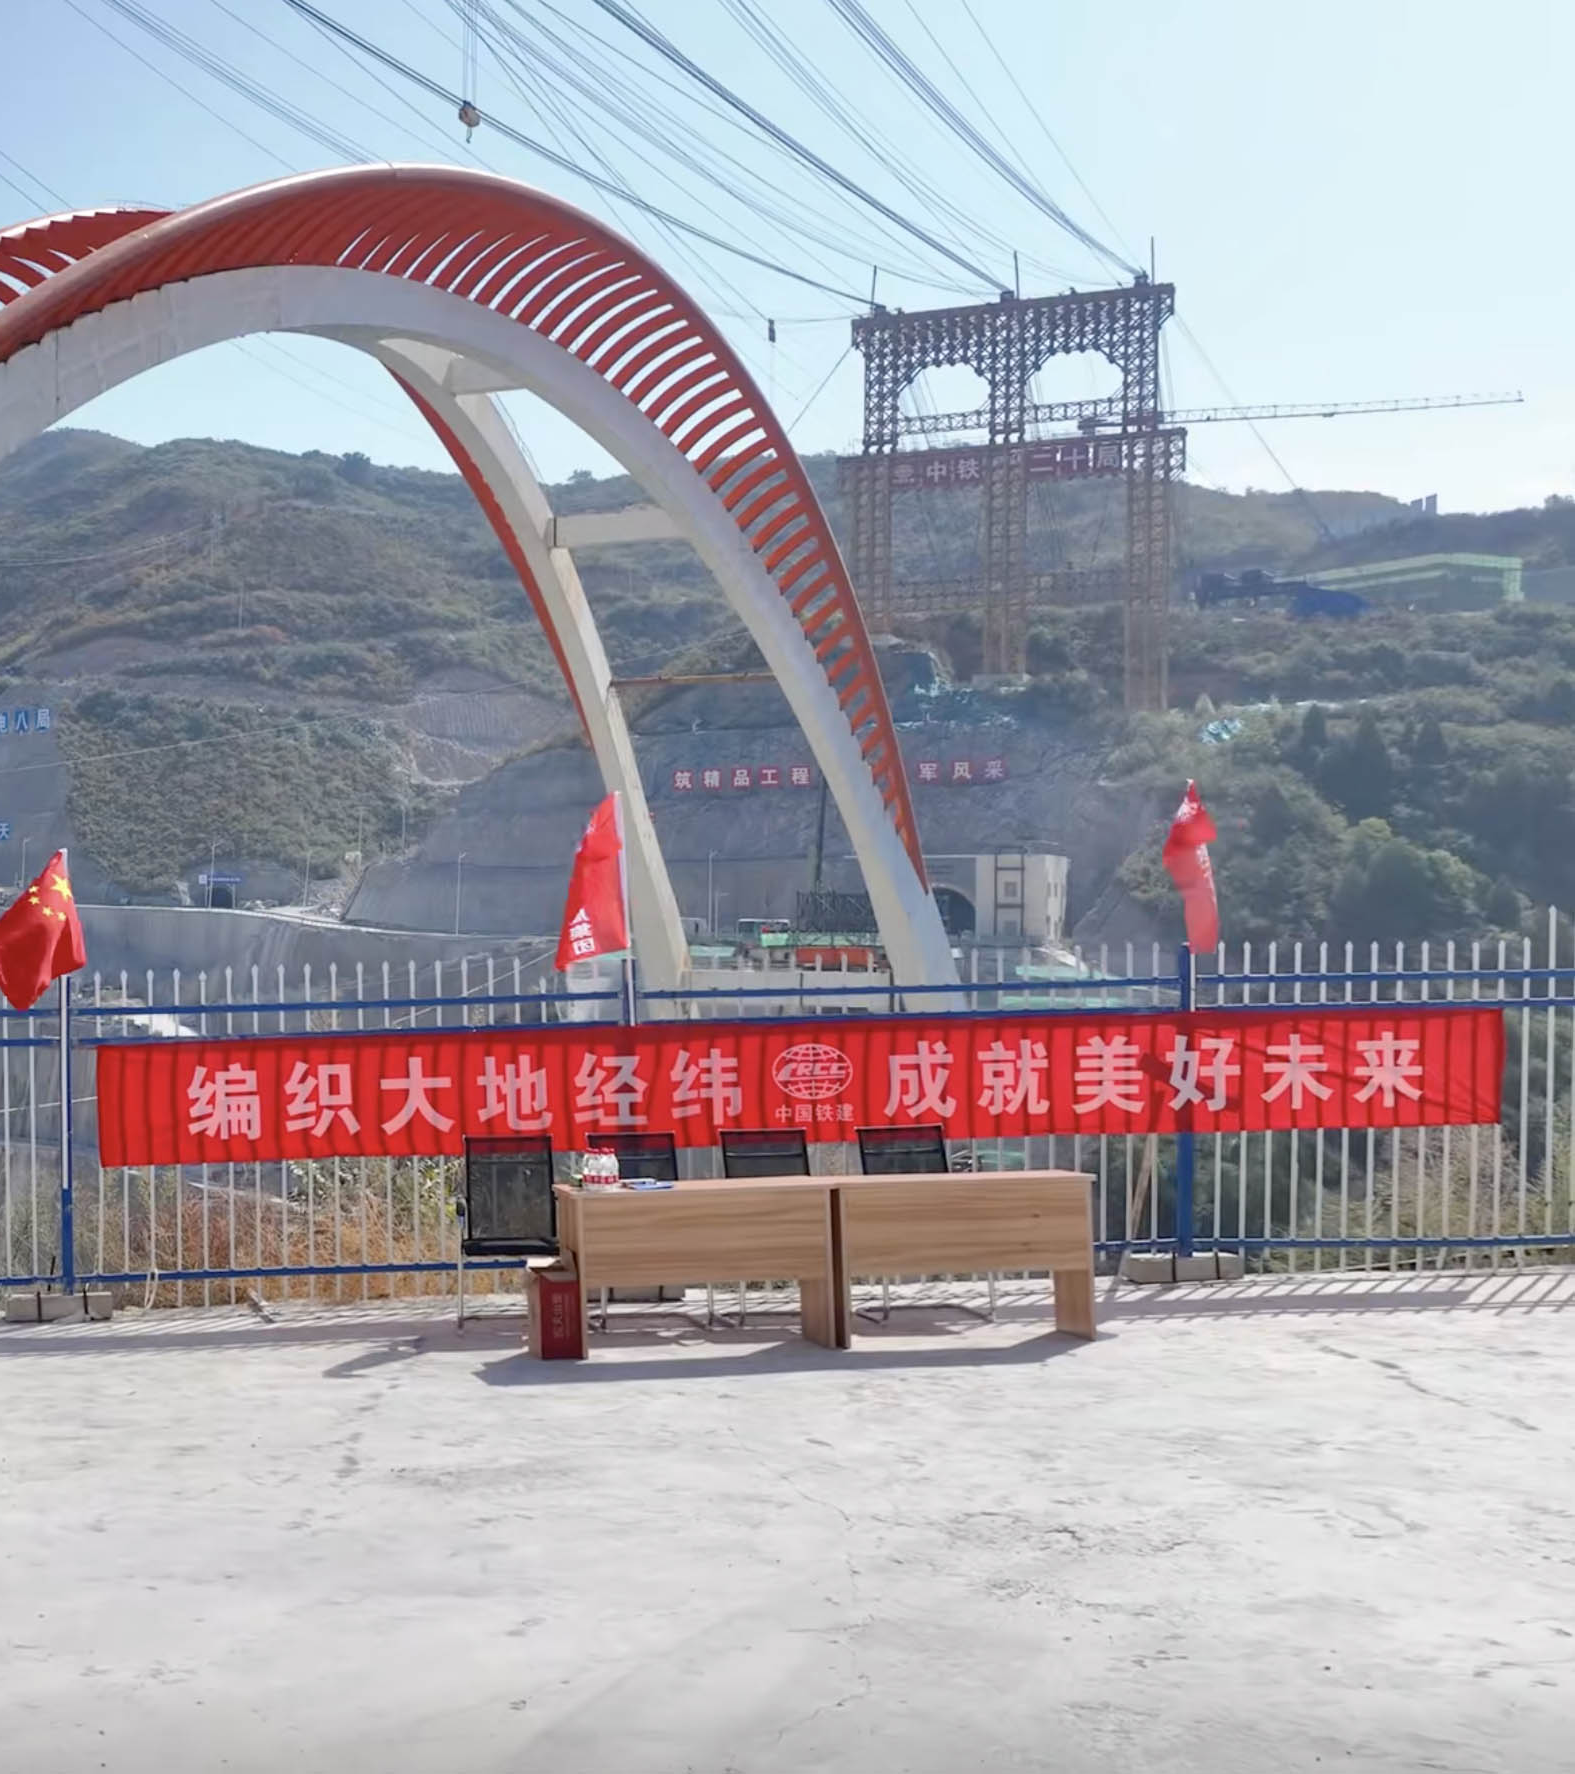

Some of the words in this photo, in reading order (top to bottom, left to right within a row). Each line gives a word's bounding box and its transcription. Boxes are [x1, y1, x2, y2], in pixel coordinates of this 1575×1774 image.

[674, 766, 810, 790] 筑精品工程
[186, 1047, 744, 1142] 编织大地经纬
[883, 1030, 1425, 1119] 成就美好未来
[775, 1102, 855, 1123] 中国铁建
